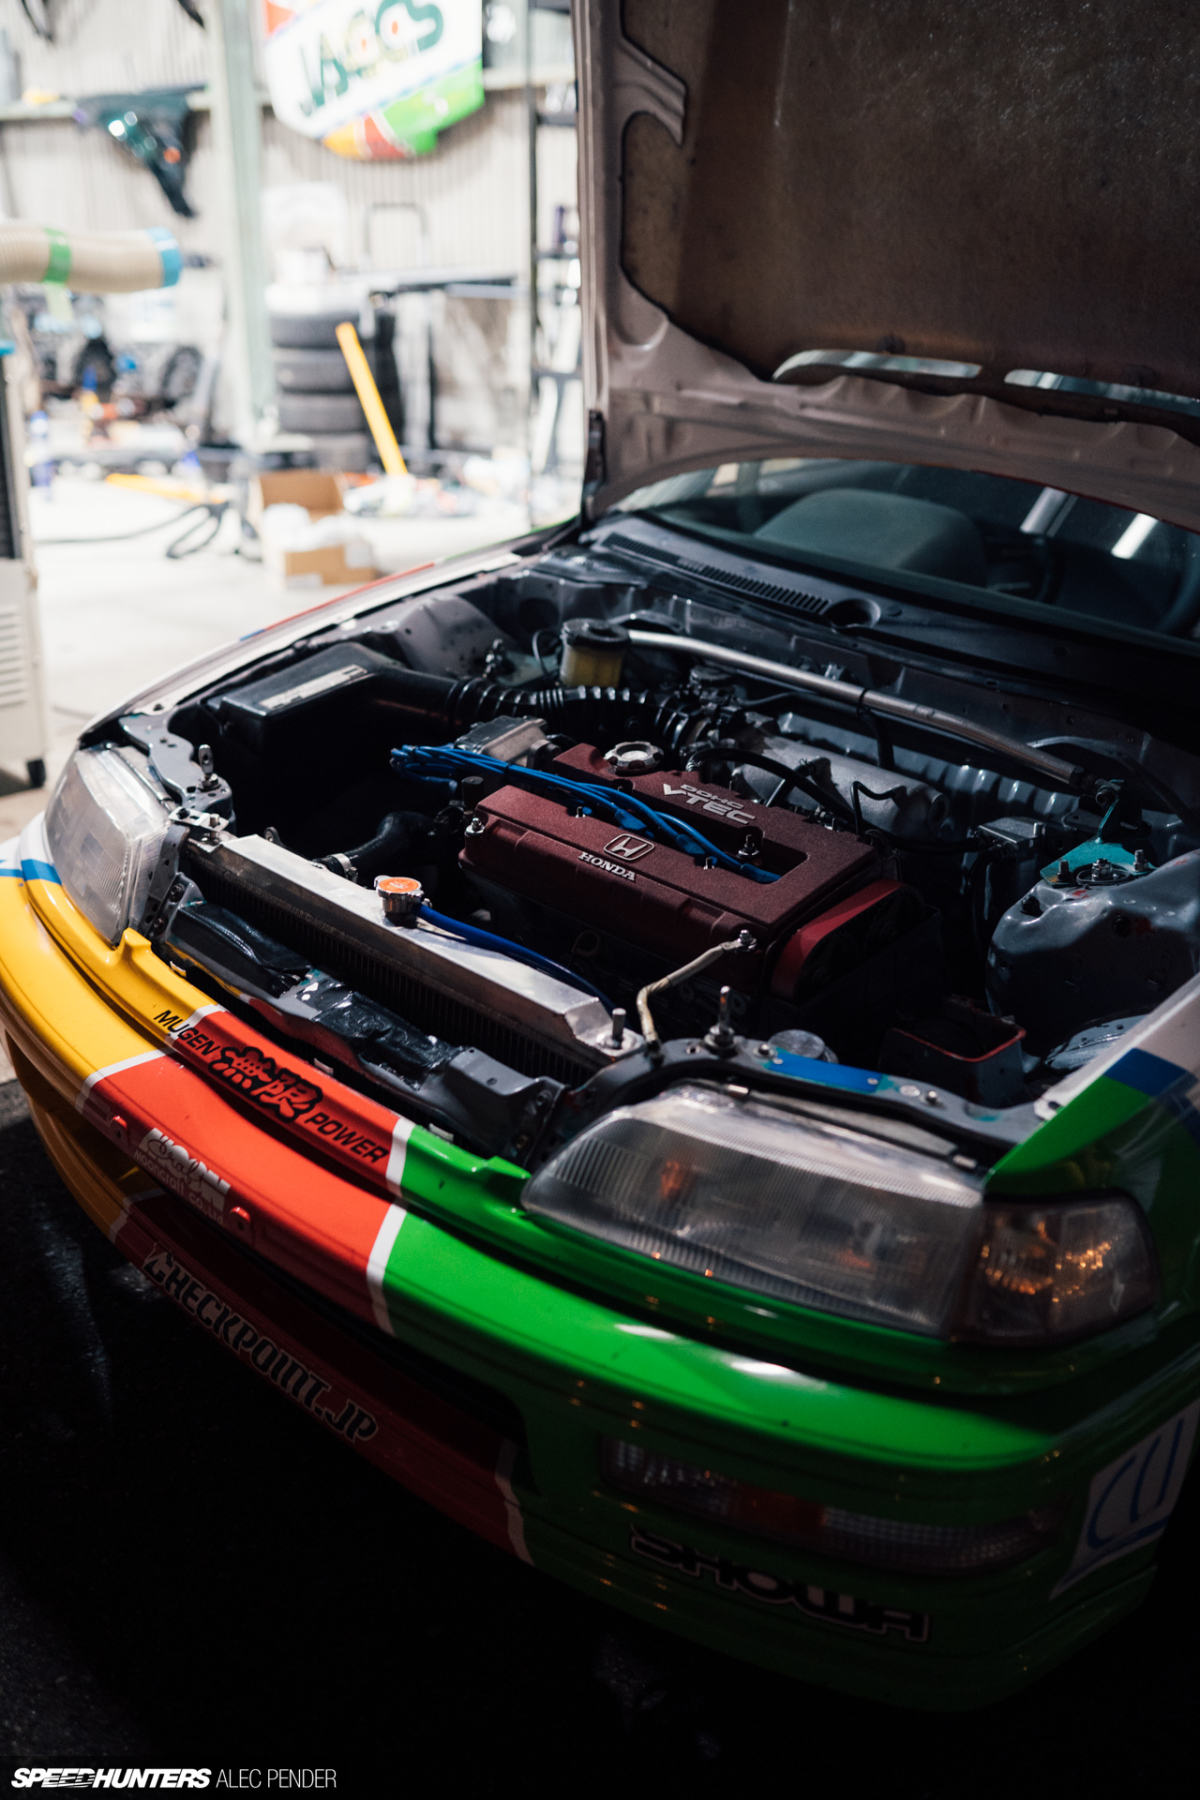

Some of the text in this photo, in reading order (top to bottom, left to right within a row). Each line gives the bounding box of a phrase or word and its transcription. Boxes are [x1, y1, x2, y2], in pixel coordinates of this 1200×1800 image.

[662, 783, 756, 825] VTEC
[681, 784, 745, 810] DOHC
[578, 851, 637, 883] HONDA
[153, 1009, 389, 1164] MUGEN 無限 POWER
[142, 1243, 379, 1443] CHECKPOINT.JP
[629, 1525, 932, 1644] SHOWA
